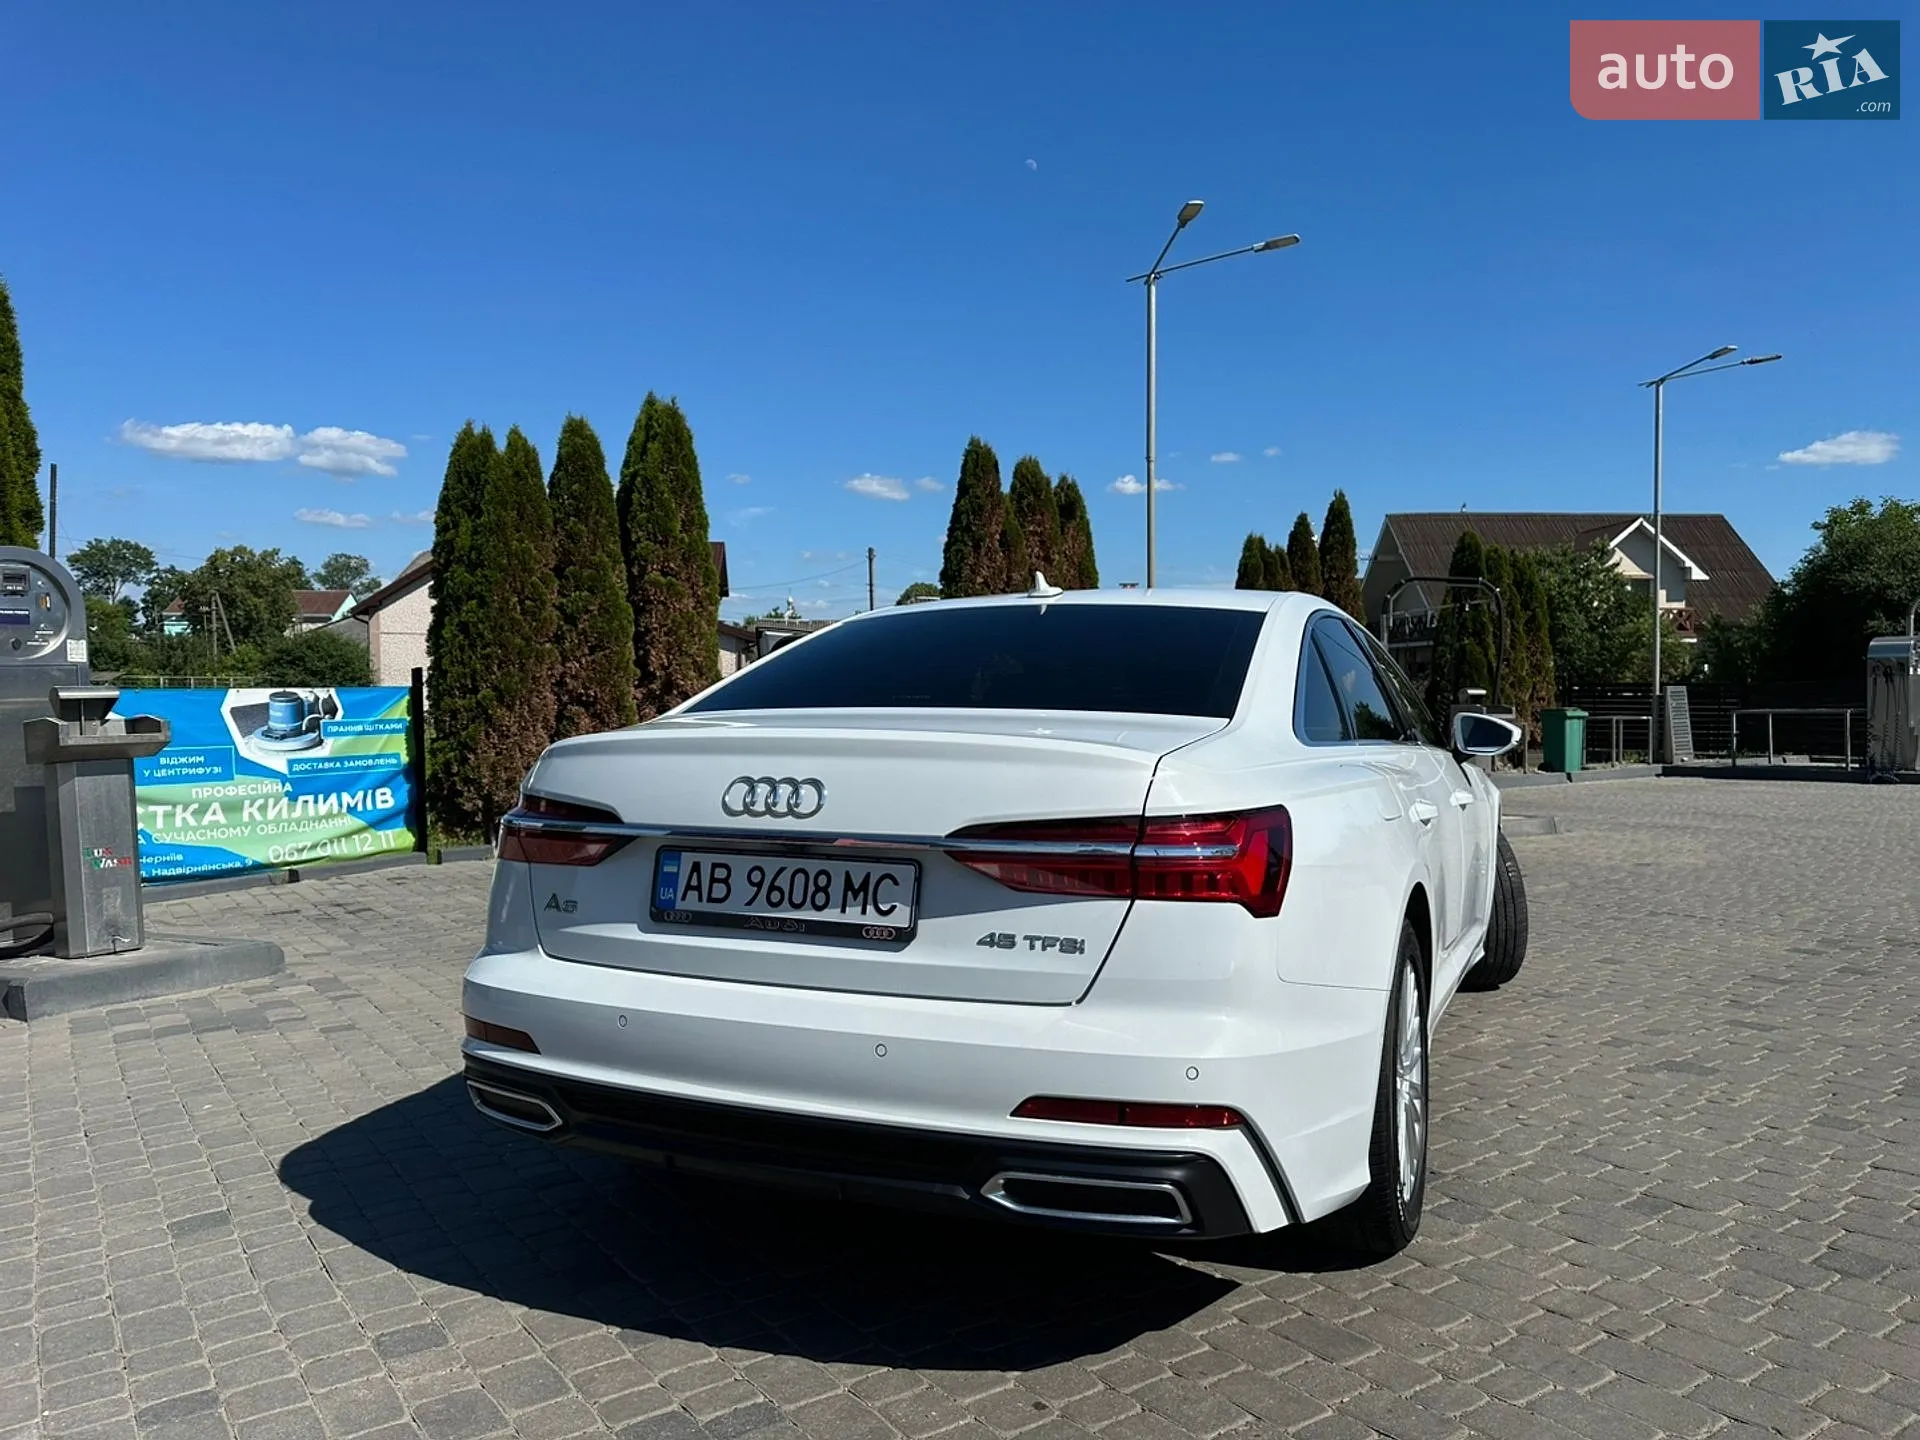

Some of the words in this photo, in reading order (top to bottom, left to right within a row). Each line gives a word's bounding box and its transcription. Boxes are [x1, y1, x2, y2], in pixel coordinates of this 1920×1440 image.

[160, 755, 205, 765] ВІДЖИМ
[292, 762, 341, 772] ДОСТАВКА
[343, 758, 398, 768] ЗАМОВЛЕНЬ
[143, 769, 151, 777] У
[153, 766, 222, 778] ЦЕНТРИФУЗІ
[191, 780, 293, 799] ПРОФЕСІЙНА
[242, 787, 396, 823] КИЛИМІВ
[151, 825, 252, 844] СУЧАСНОМУ
[256, 816, 352, 836] ОБЛАДНАННІ
[268, 841, 312, 864] 067
[316, 836, 349, 857] 011
[352, 833, 375, 852] 12
[376, 830, 396, 849] 11
[660, 887, 675, 900] UA
[744, 865, 832, 912] 9608
[976, 932, 1016, 950] 45
